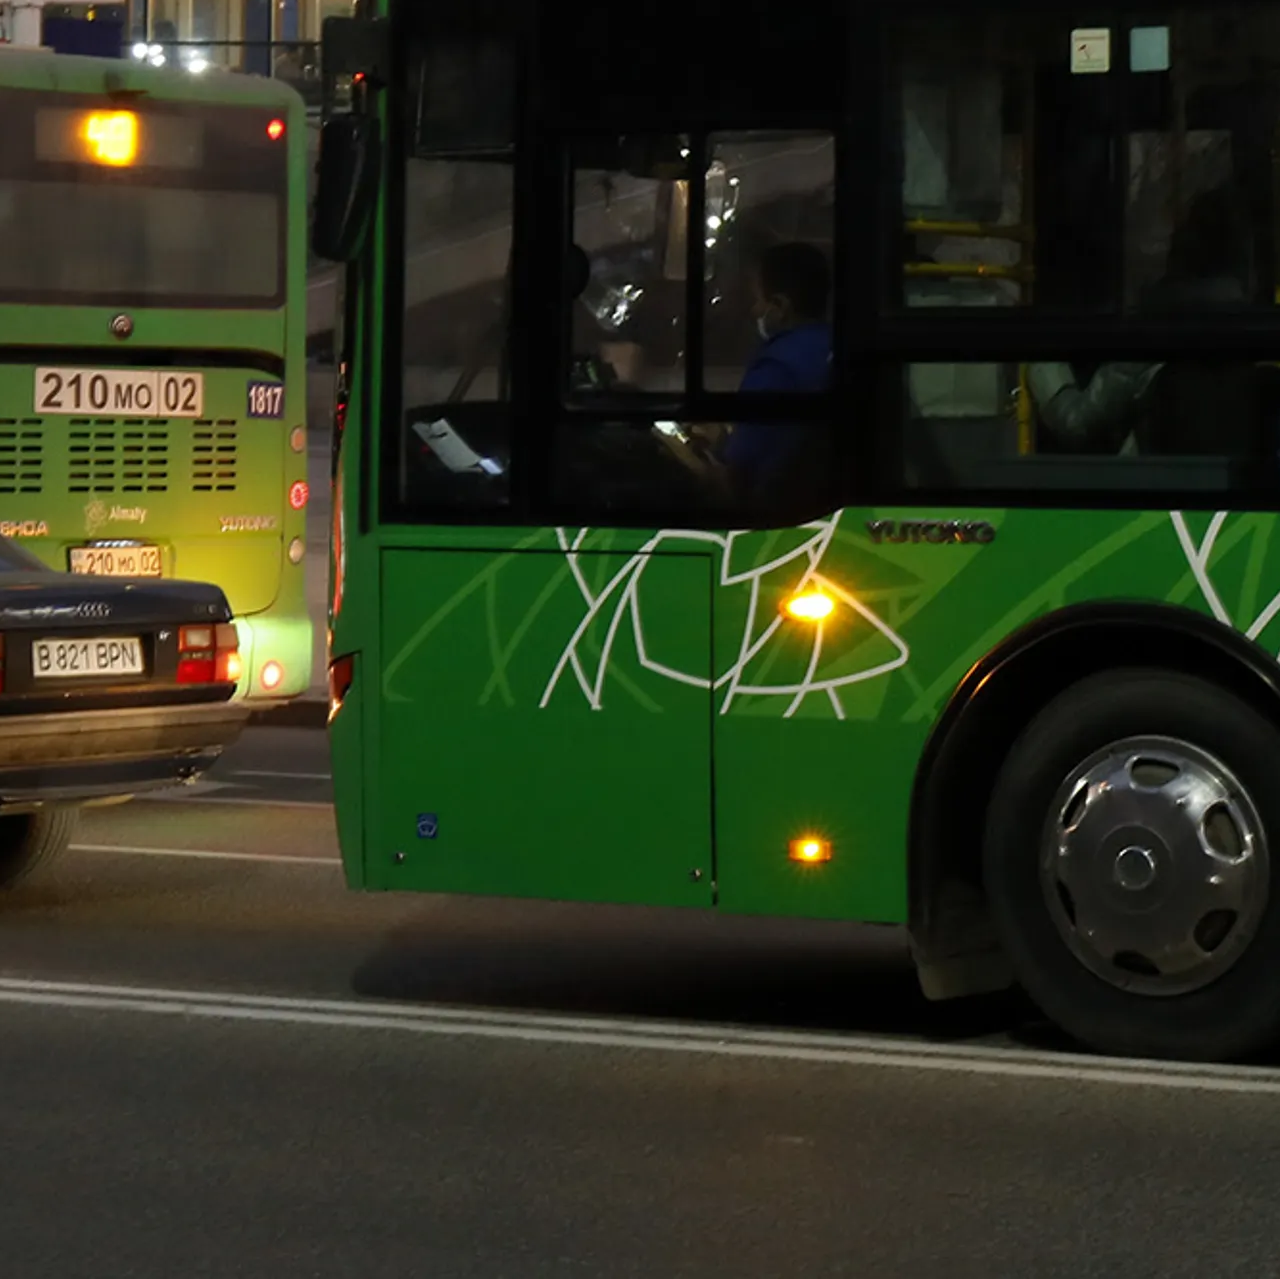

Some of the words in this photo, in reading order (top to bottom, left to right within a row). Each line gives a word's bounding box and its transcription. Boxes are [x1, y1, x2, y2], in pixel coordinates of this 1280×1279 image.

[41, 372, 109, 409] 210
[164, 376, 197, 412] 02
[248, 384, 283, 415] 1817
[86, 552, 114, 574] 210
[141, 551, 159, 572] 02
[38, 645, 51, 670] B
[56, 644, 91, 668] 821
[96, 642, 136, 668] BPN
